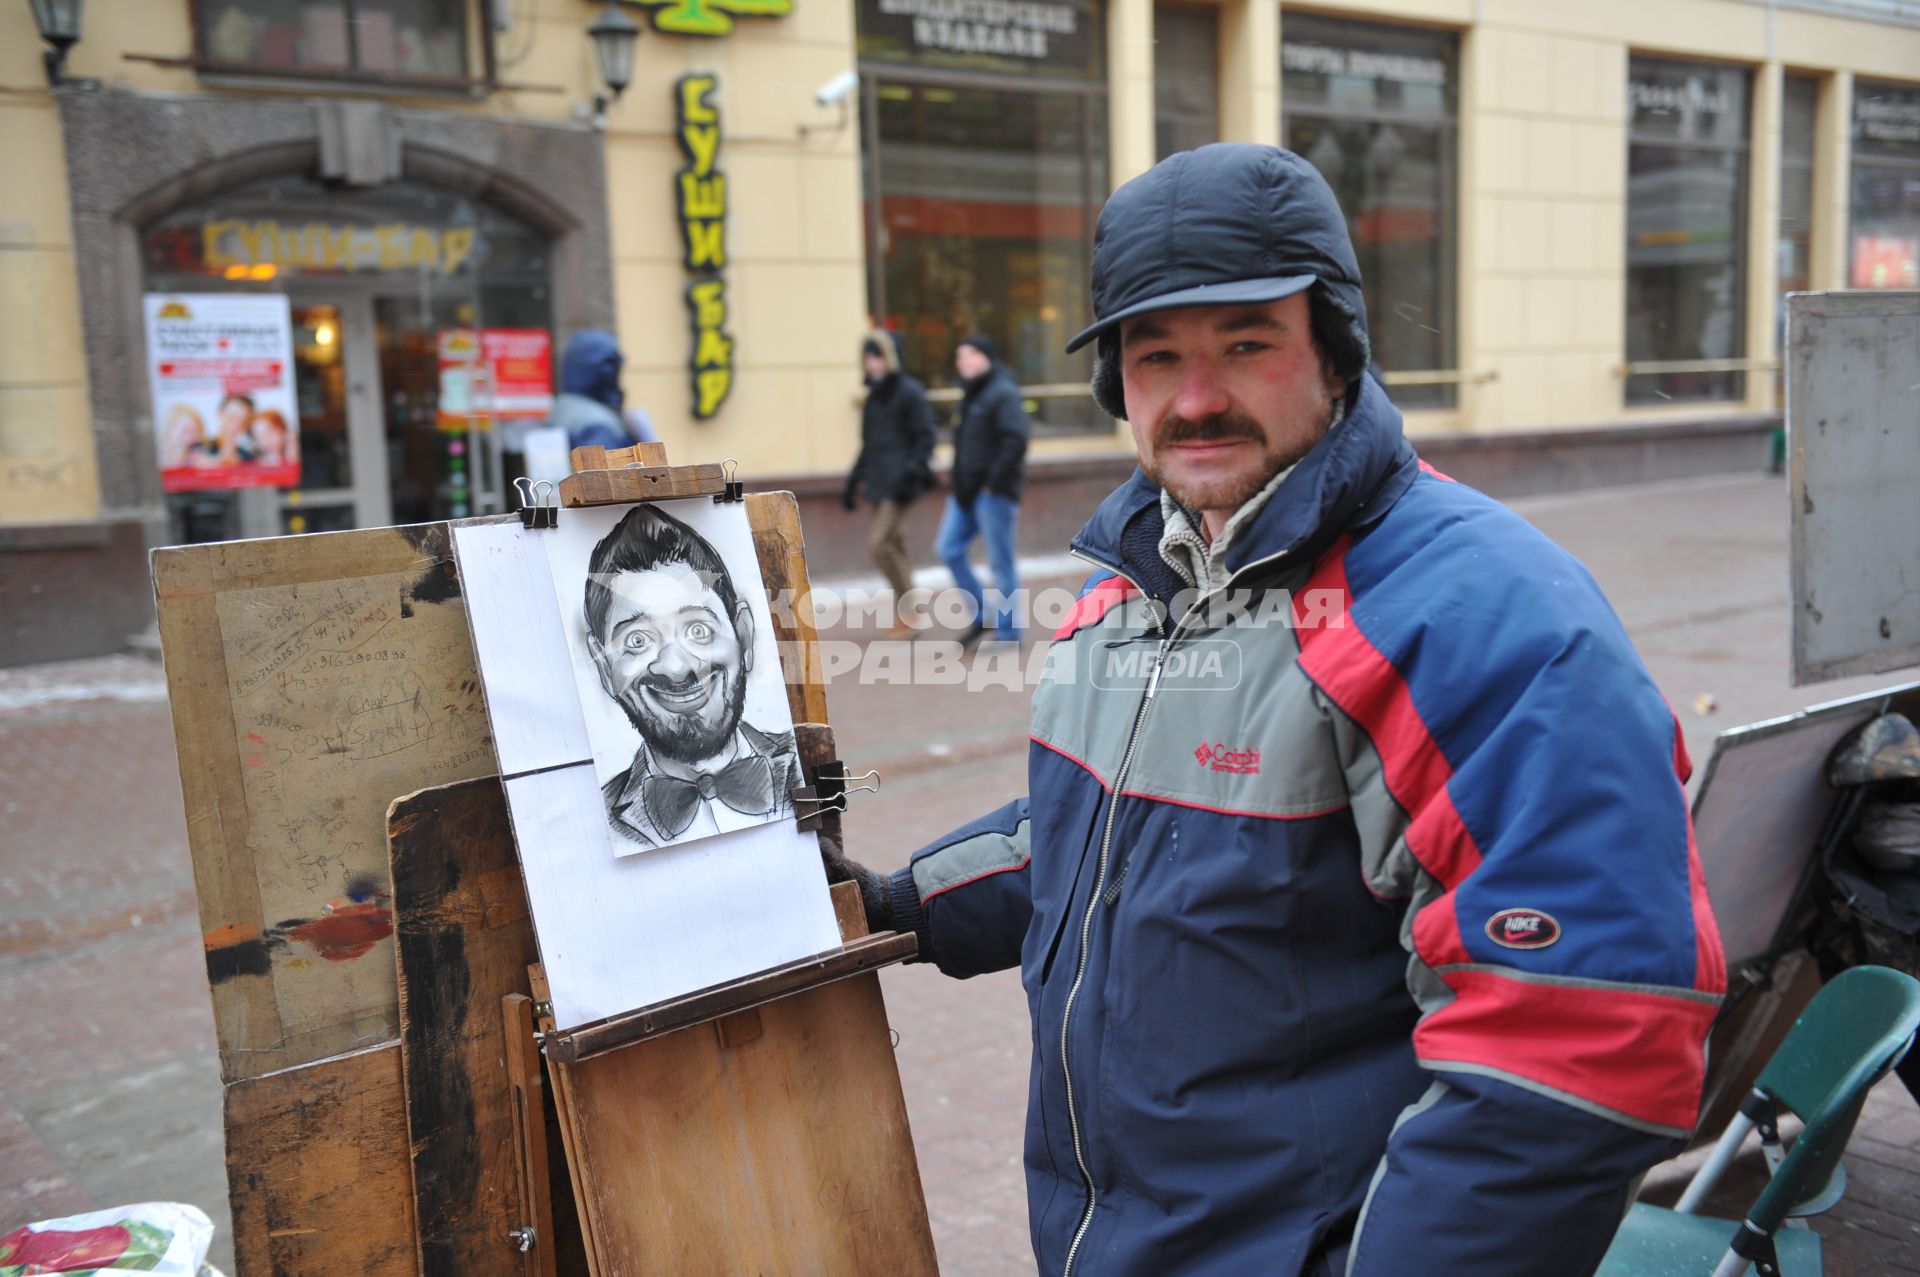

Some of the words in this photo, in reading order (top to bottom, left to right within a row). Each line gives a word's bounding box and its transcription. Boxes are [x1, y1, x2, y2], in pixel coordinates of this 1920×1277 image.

[680, 76, 727, 268] СУШИ
[690, 281, 734, 417] БАР
[1505, 916, 1541, 932] NIKE
